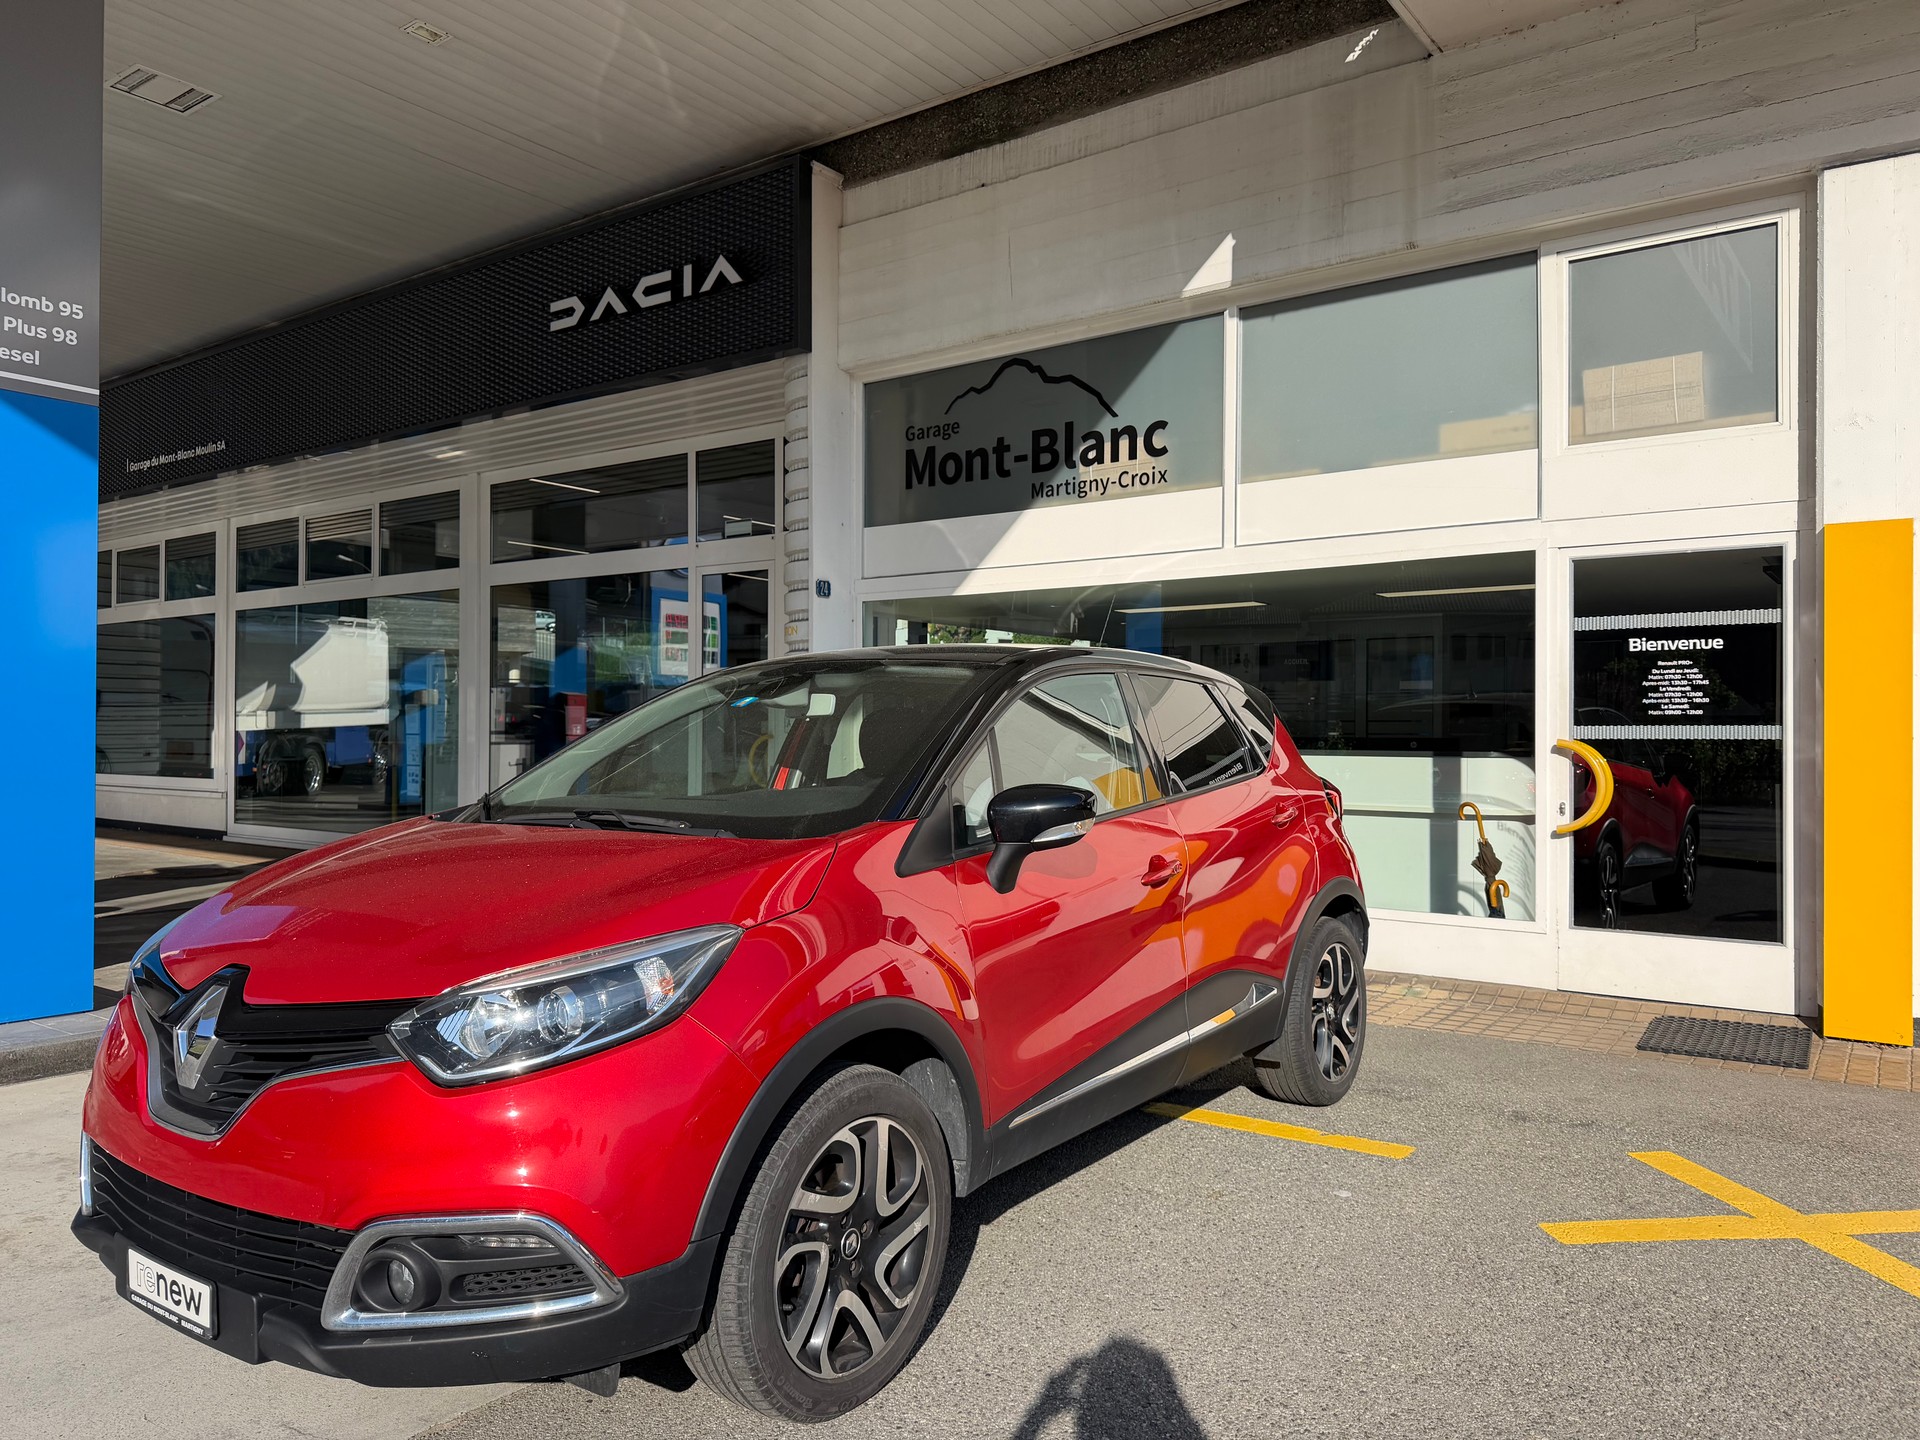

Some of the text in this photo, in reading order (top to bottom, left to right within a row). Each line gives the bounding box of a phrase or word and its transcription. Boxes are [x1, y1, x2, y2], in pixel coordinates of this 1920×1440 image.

[0, 286, 84, 320] lomb 95
[550, 254, 744, 332] DACIA
[3, 315, 78, 346] Plus 98
[0, 346, 40, 366] esel
[904, 419, 961, 442] Garage
[129, 439, 226, 472] Garage du Mont-Blanc Moulin SA
[904, 419, 1170, 490] Mont-Blanc
[1031, 466, 1169, 500] Martigny-Croix
[820, 581, 829, 596] 24
[1628, 637, 1724, 653] Bienvenue
[136, 1260, 202, 1316] renew
[130, 1293, 205, 1336] GARAGE DU MONT-BLANC MARTIGNY
